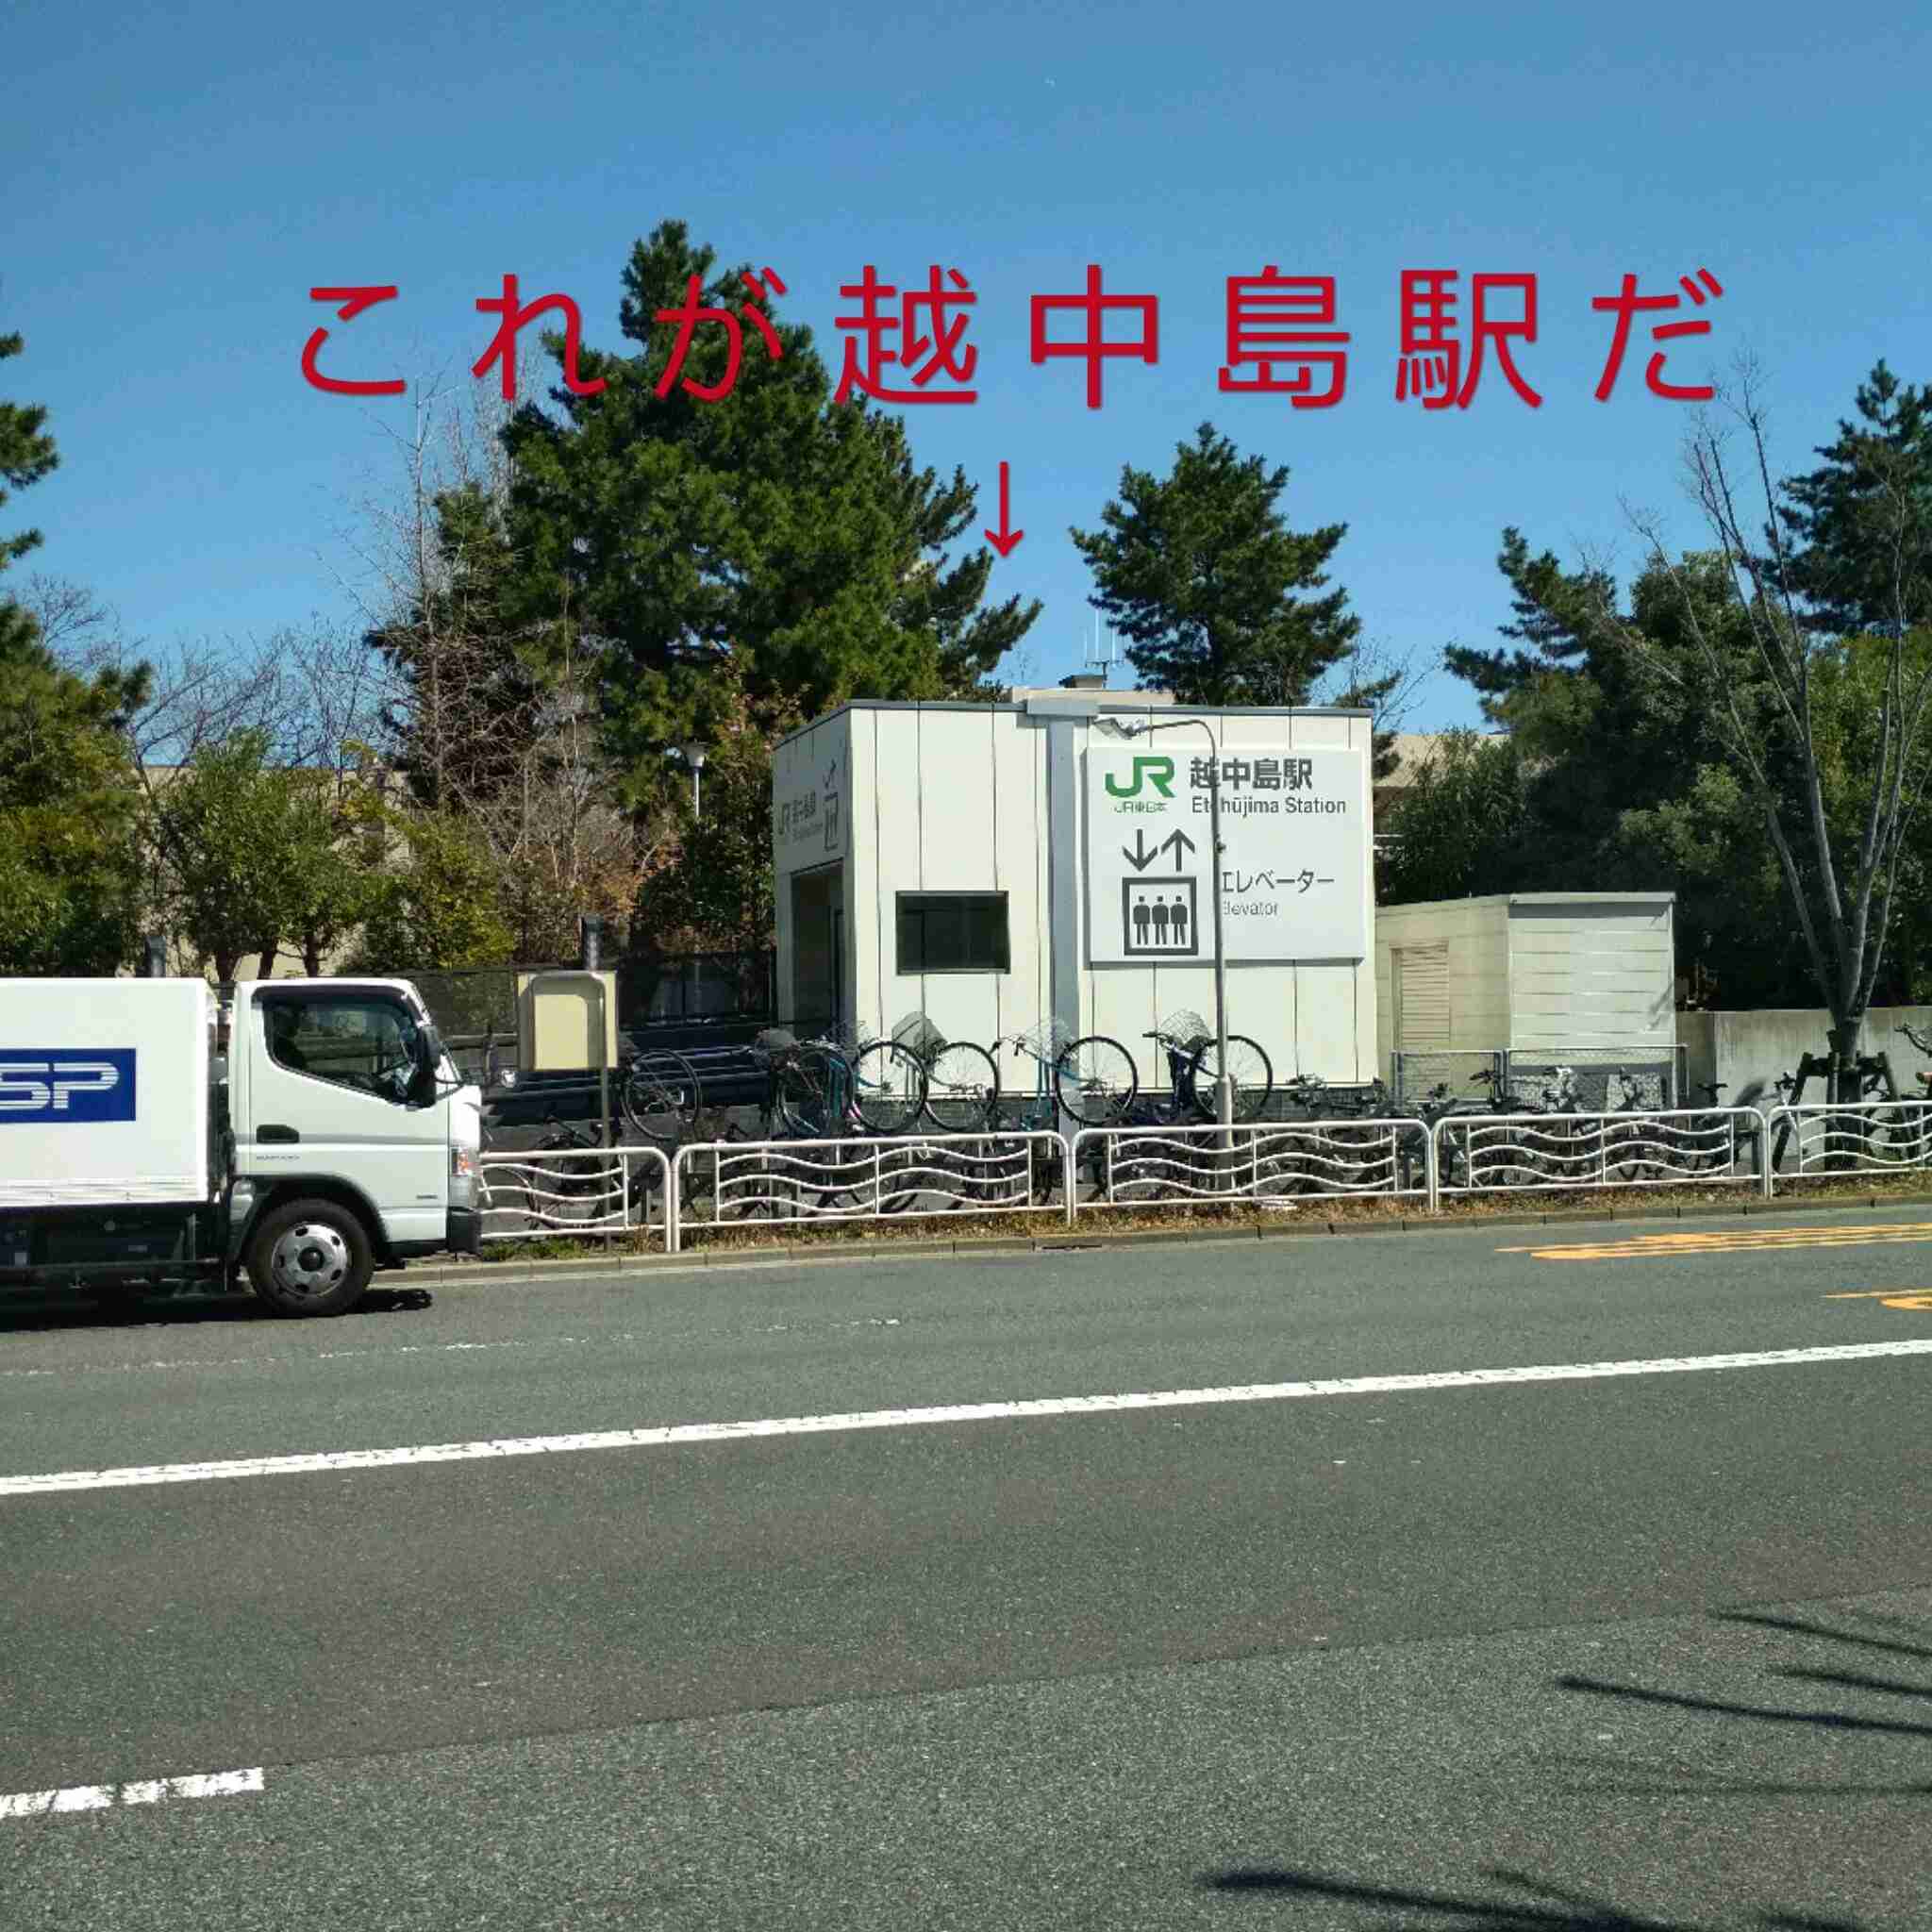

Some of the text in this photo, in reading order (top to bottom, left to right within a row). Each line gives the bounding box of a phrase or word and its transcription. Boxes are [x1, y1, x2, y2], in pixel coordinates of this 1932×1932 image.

[1105, 757, 1175, 797] JR
[1190, 757, 1313, 791] 越中島駅
[1191, 794, 1346, 818] Ethūjima Station
[1223, 869, 1335, 893] エレベーター
